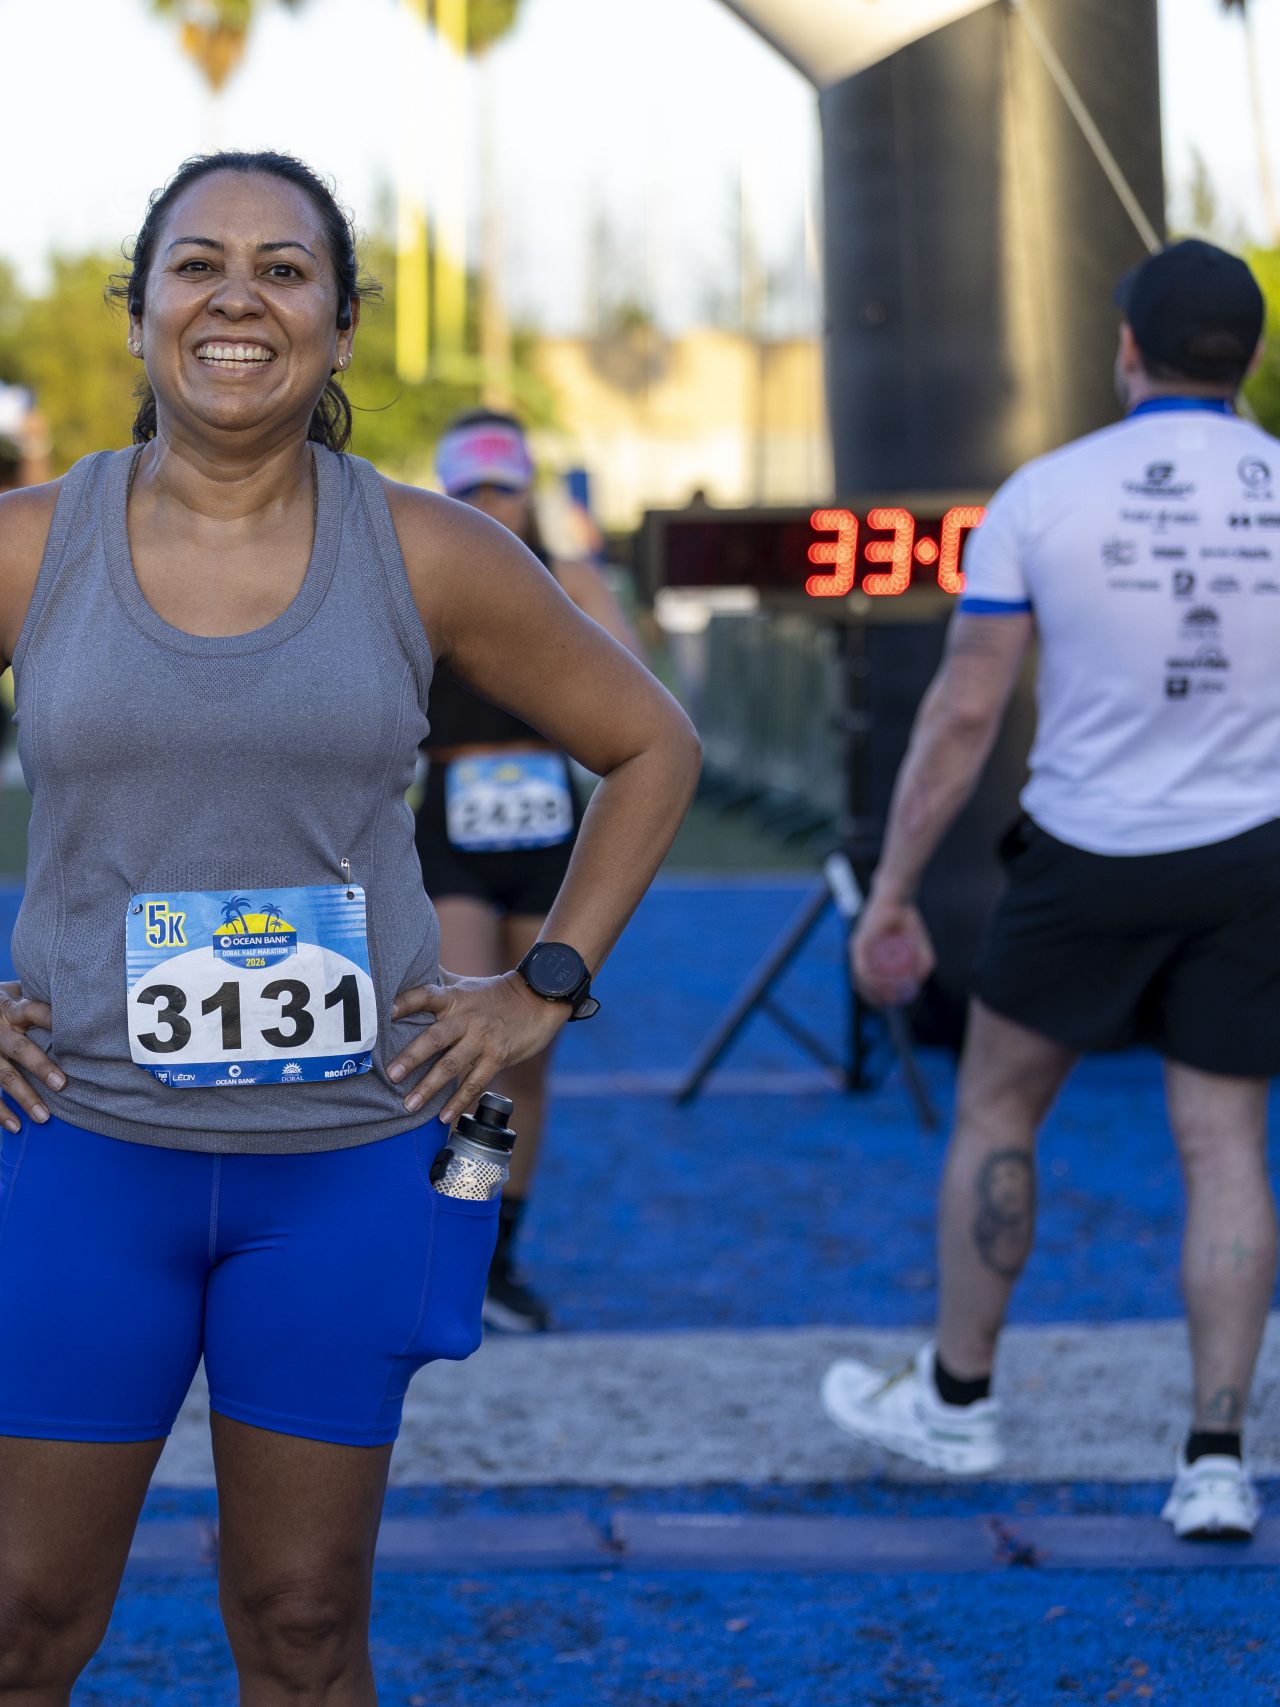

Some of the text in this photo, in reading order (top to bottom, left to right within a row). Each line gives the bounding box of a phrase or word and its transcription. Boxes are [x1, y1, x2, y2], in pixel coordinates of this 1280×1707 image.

[147, 903, 186, 945] 5K
[233, 936, 287, 946] OCEAN BANK
[222, 947, 288, 957] DORAL HALF MARATHON
[246, 957, 266, 967] 2026
[137, 974, 362, 1054] 3131
